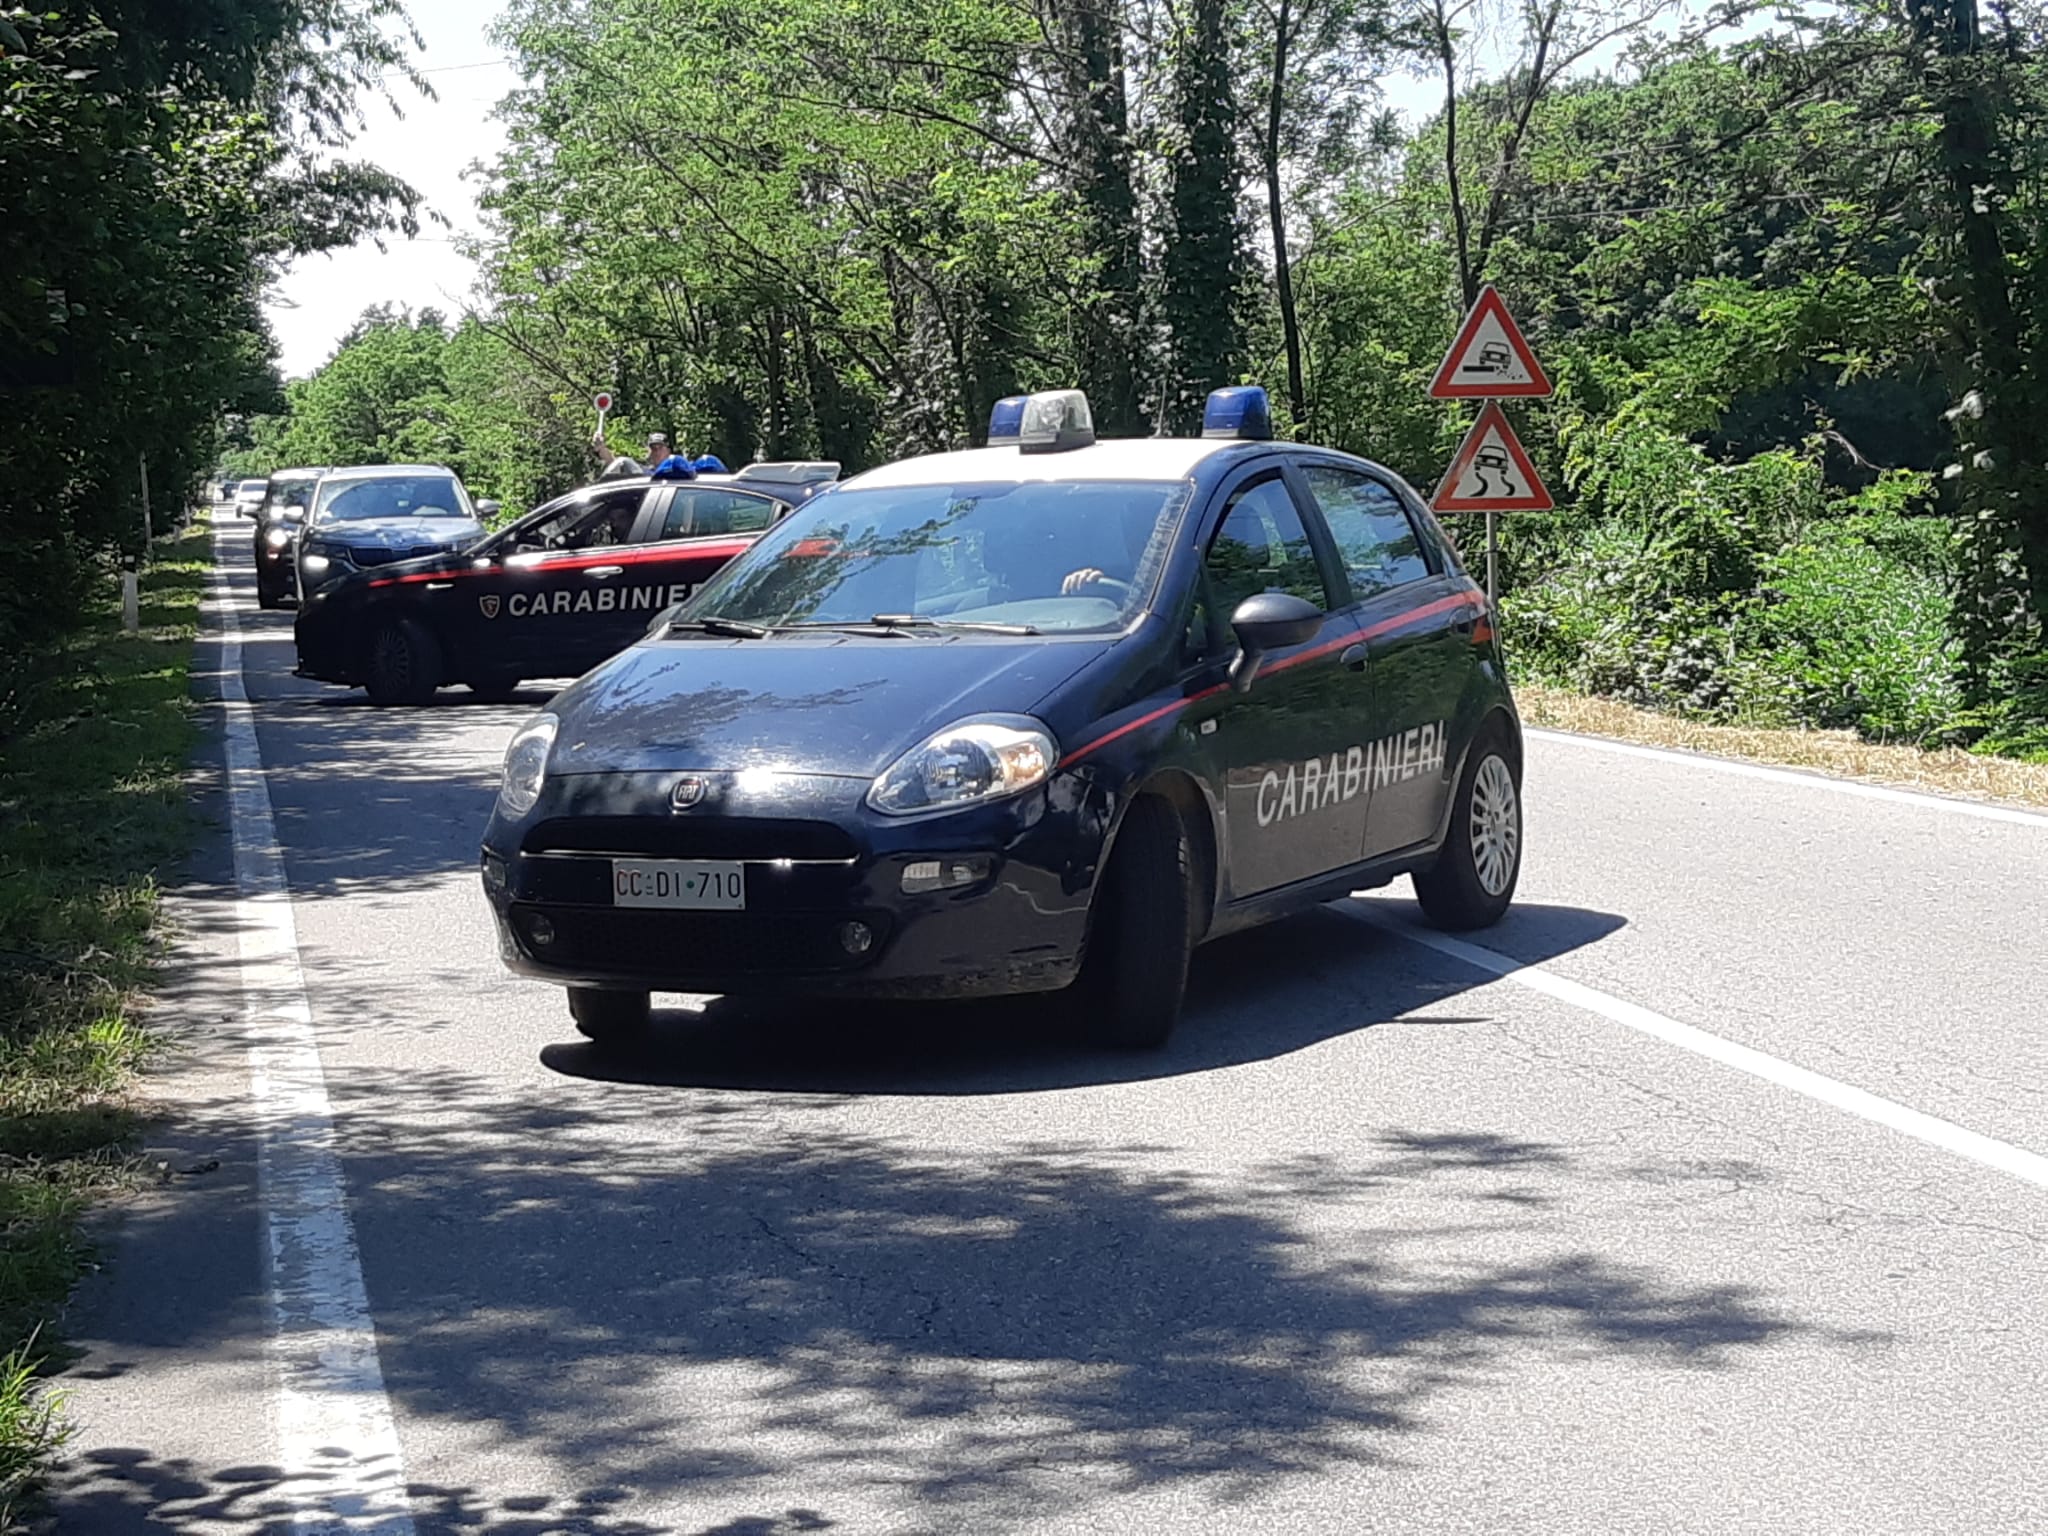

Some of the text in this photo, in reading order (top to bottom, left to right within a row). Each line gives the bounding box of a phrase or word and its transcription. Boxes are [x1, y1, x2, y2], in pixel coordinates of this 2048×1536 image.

[1256, 719, 1445, 828] CARABINIERI
[616, 869, 643, 896] CC
[697, 872, 741, 898] 710
